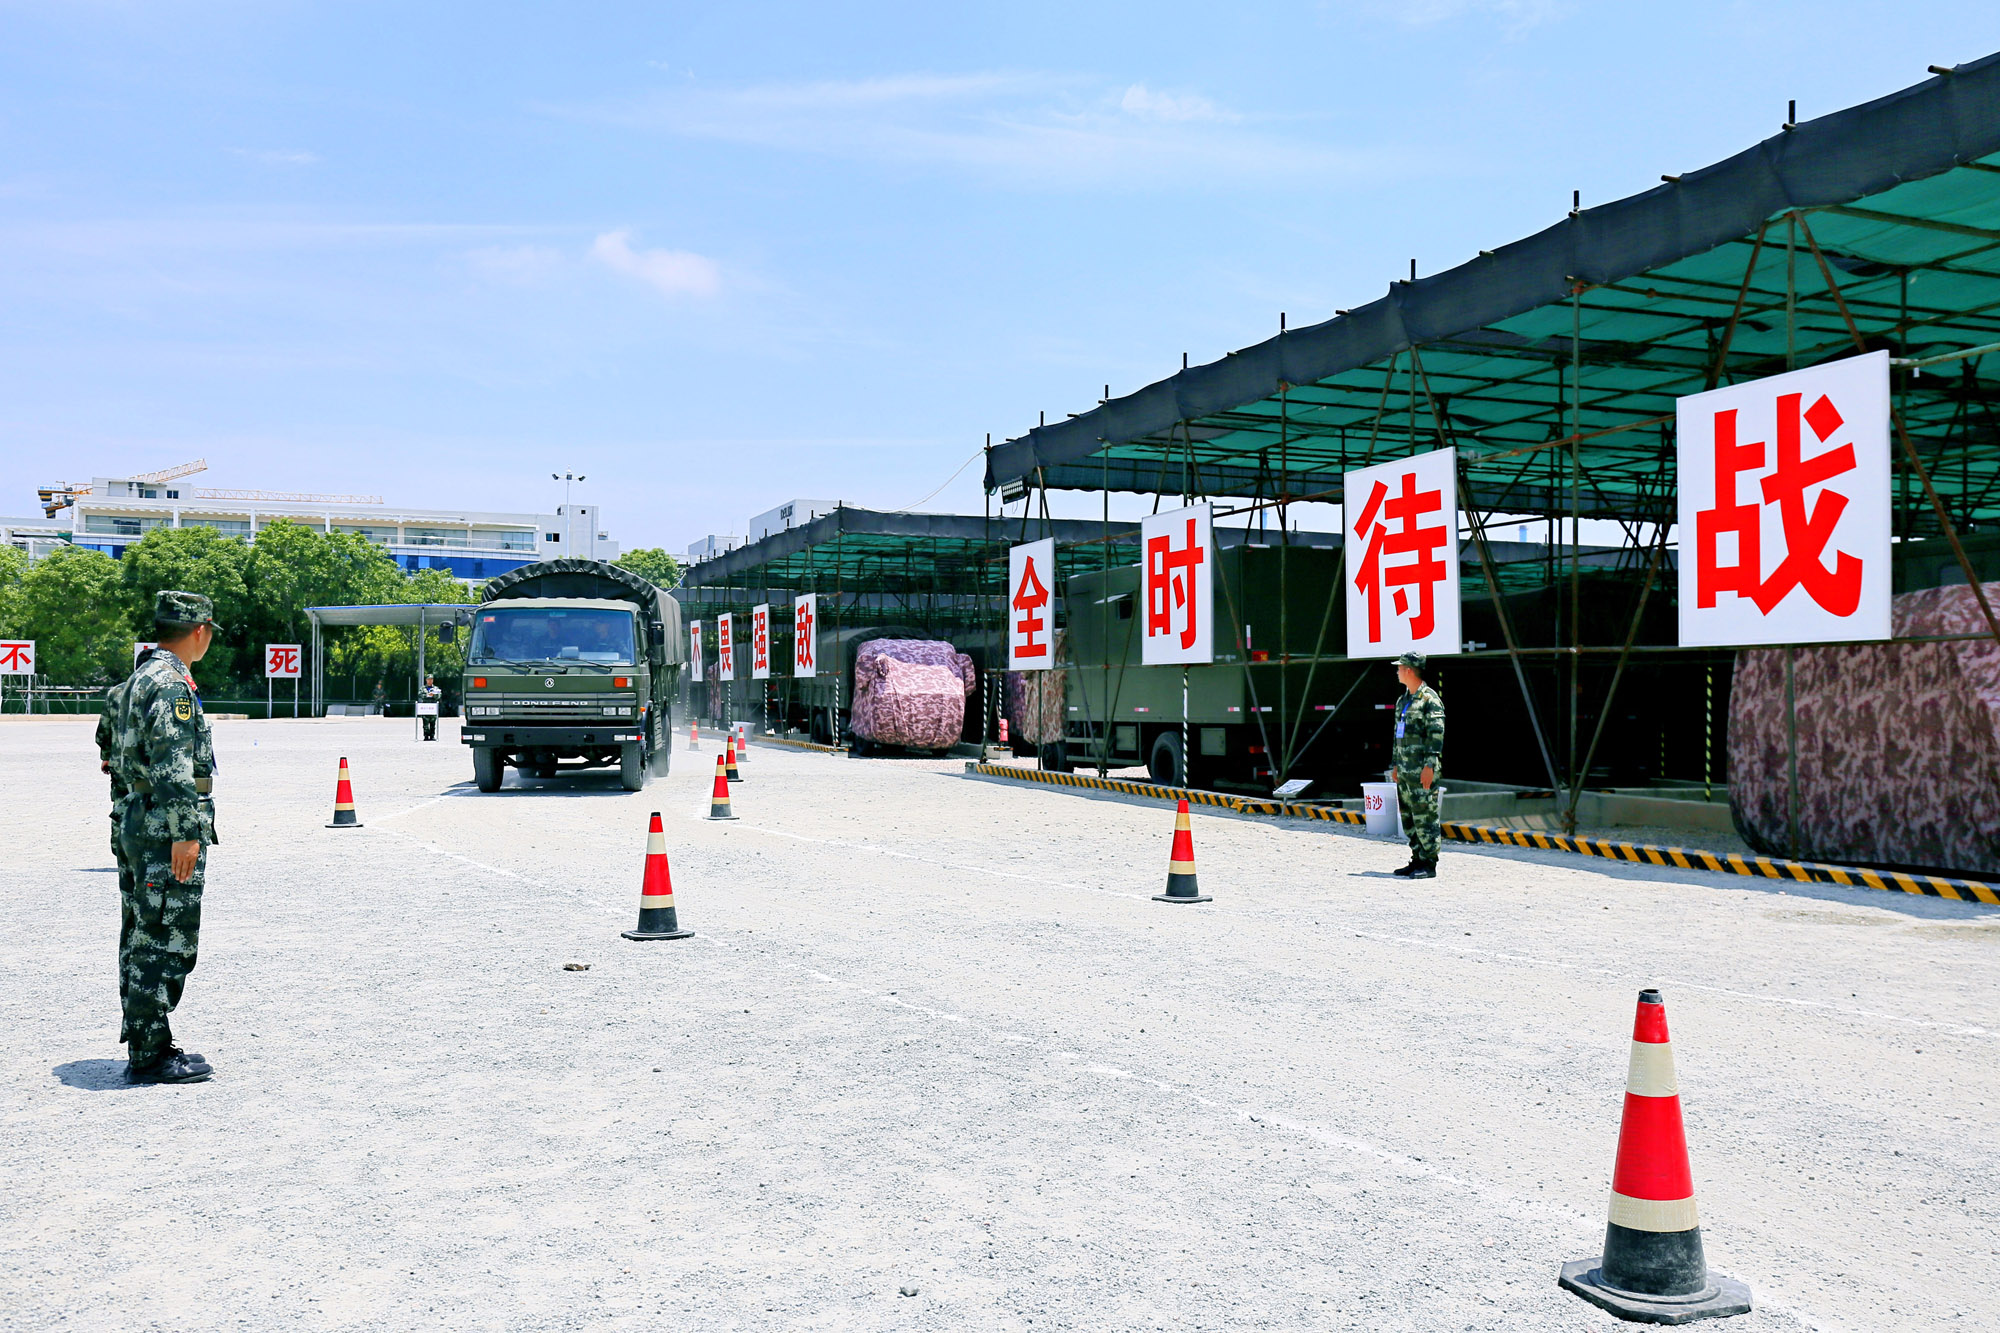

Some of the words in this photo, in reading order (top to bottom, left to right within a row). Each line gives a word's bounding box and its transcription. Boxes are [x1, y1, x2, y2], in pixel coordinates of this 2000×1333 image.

[1696, 392, 1864, 618] 战
[1147, 518, 1204, 650] 时
[1353, 472, 1448, 644] 待
[797, 602, 813, 669] 敌
[1012, 556, 1049, 658] 全
[0, 643, 32, 671] 不
[269, 647, 299, 674] 死
[692, 627, 701, 674] 不
[720, 619, 731, 673] 畏
[754, 611, 767, 671] 强
